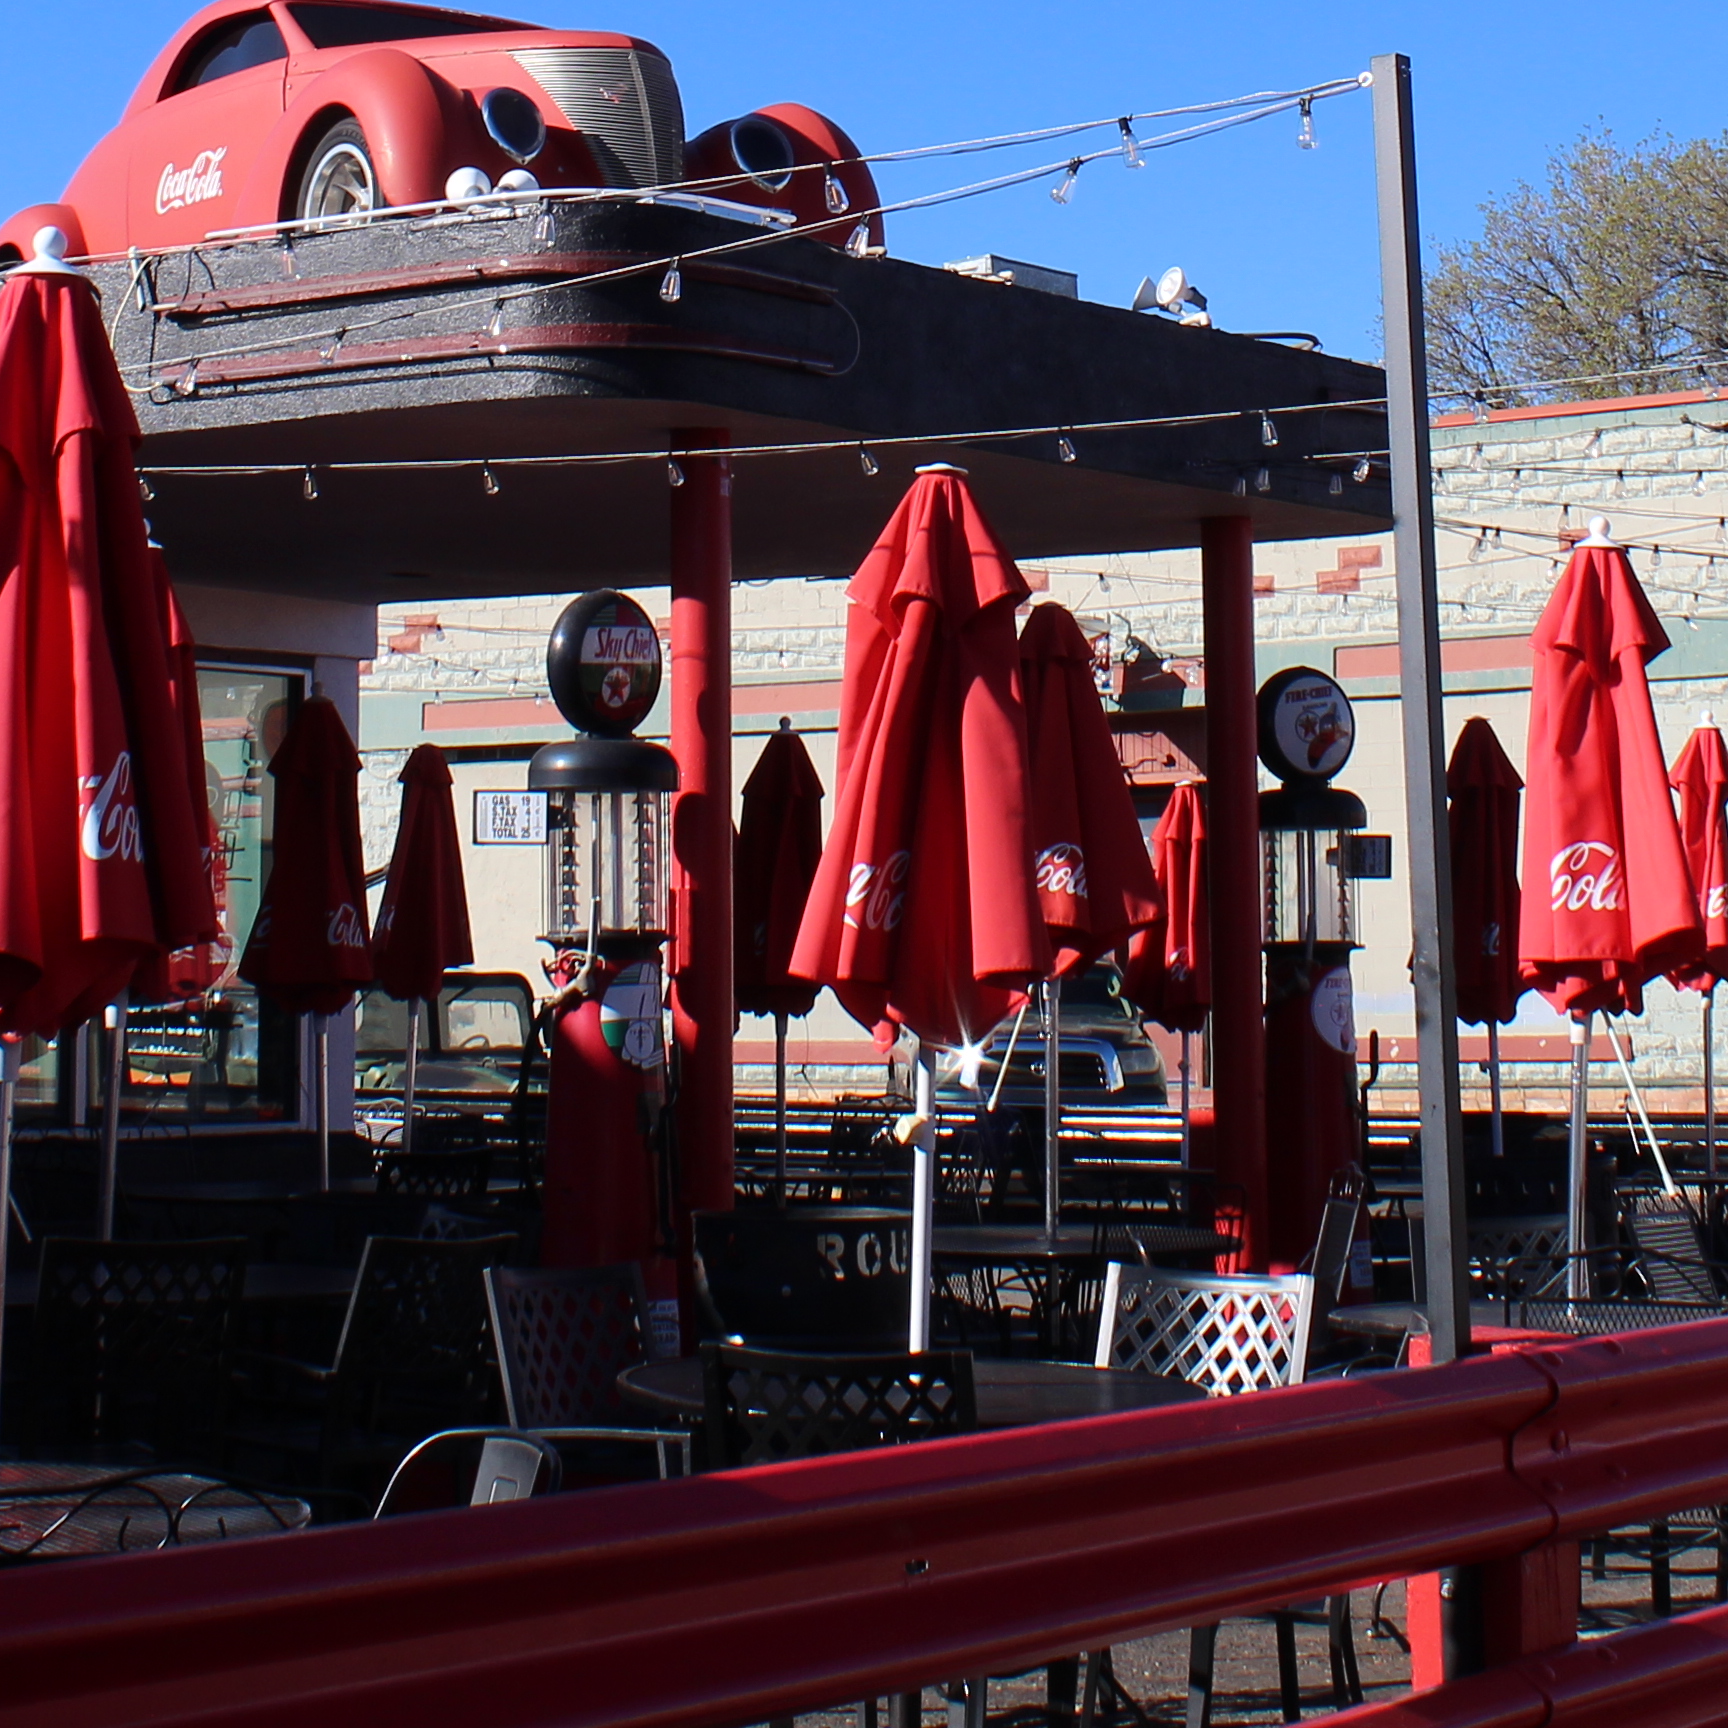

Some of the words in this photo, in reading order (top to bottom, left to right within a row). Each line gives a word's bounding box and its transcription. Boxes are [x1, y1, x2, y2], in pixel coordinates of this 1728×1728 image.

[594, 628, 622, 662] Sky
[492, 795, 510, 806] GAS
[492, 827, 519, 838] TOTAL
